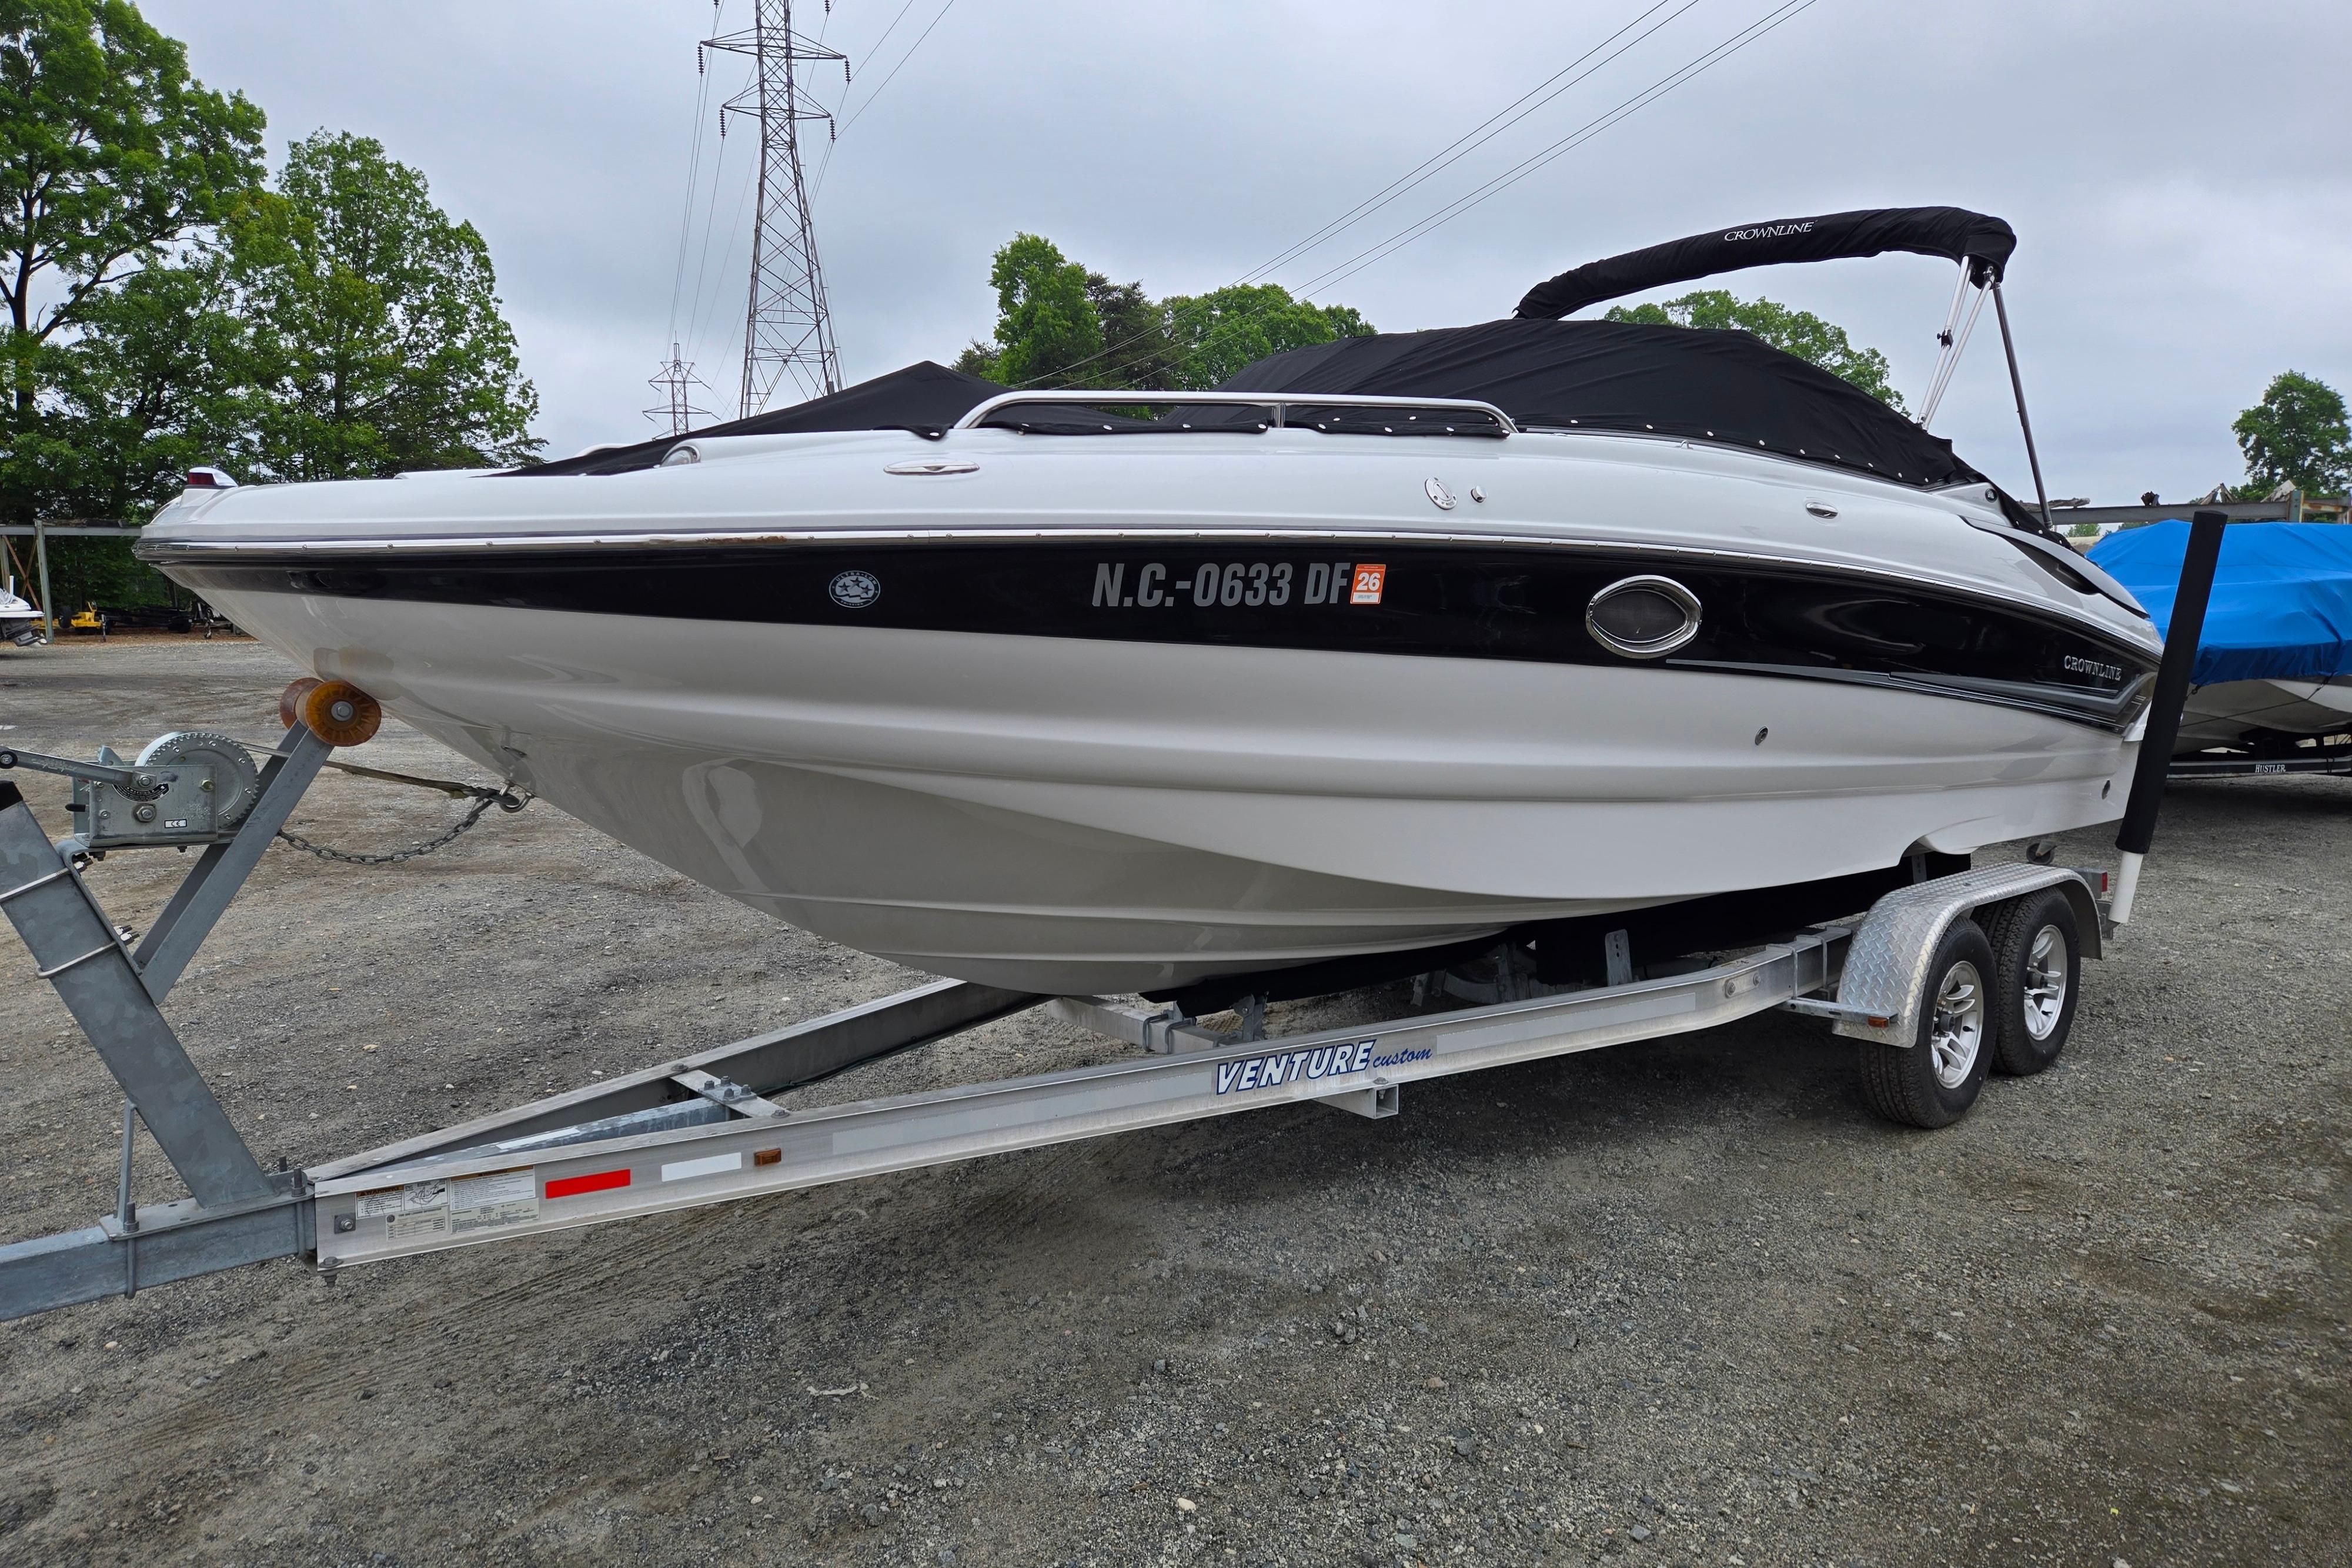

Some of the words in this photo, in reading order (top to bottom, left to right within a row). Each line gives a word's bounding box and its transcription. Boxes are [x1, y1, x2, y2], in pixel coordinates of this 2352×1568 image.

[1724, 221, 1815, 242] CROWNLINE
[1304, 562, 1351, 604] DF
[1356, 572, 1381, 591] 26
[2064, 655, 2122, 681] CROWNLINE
[2255, 764, 2286, 773] HUSTLER
[1216, 1039, 1377, 1095] VENTURE
[1372, 1048, 1432, 1069] custom
